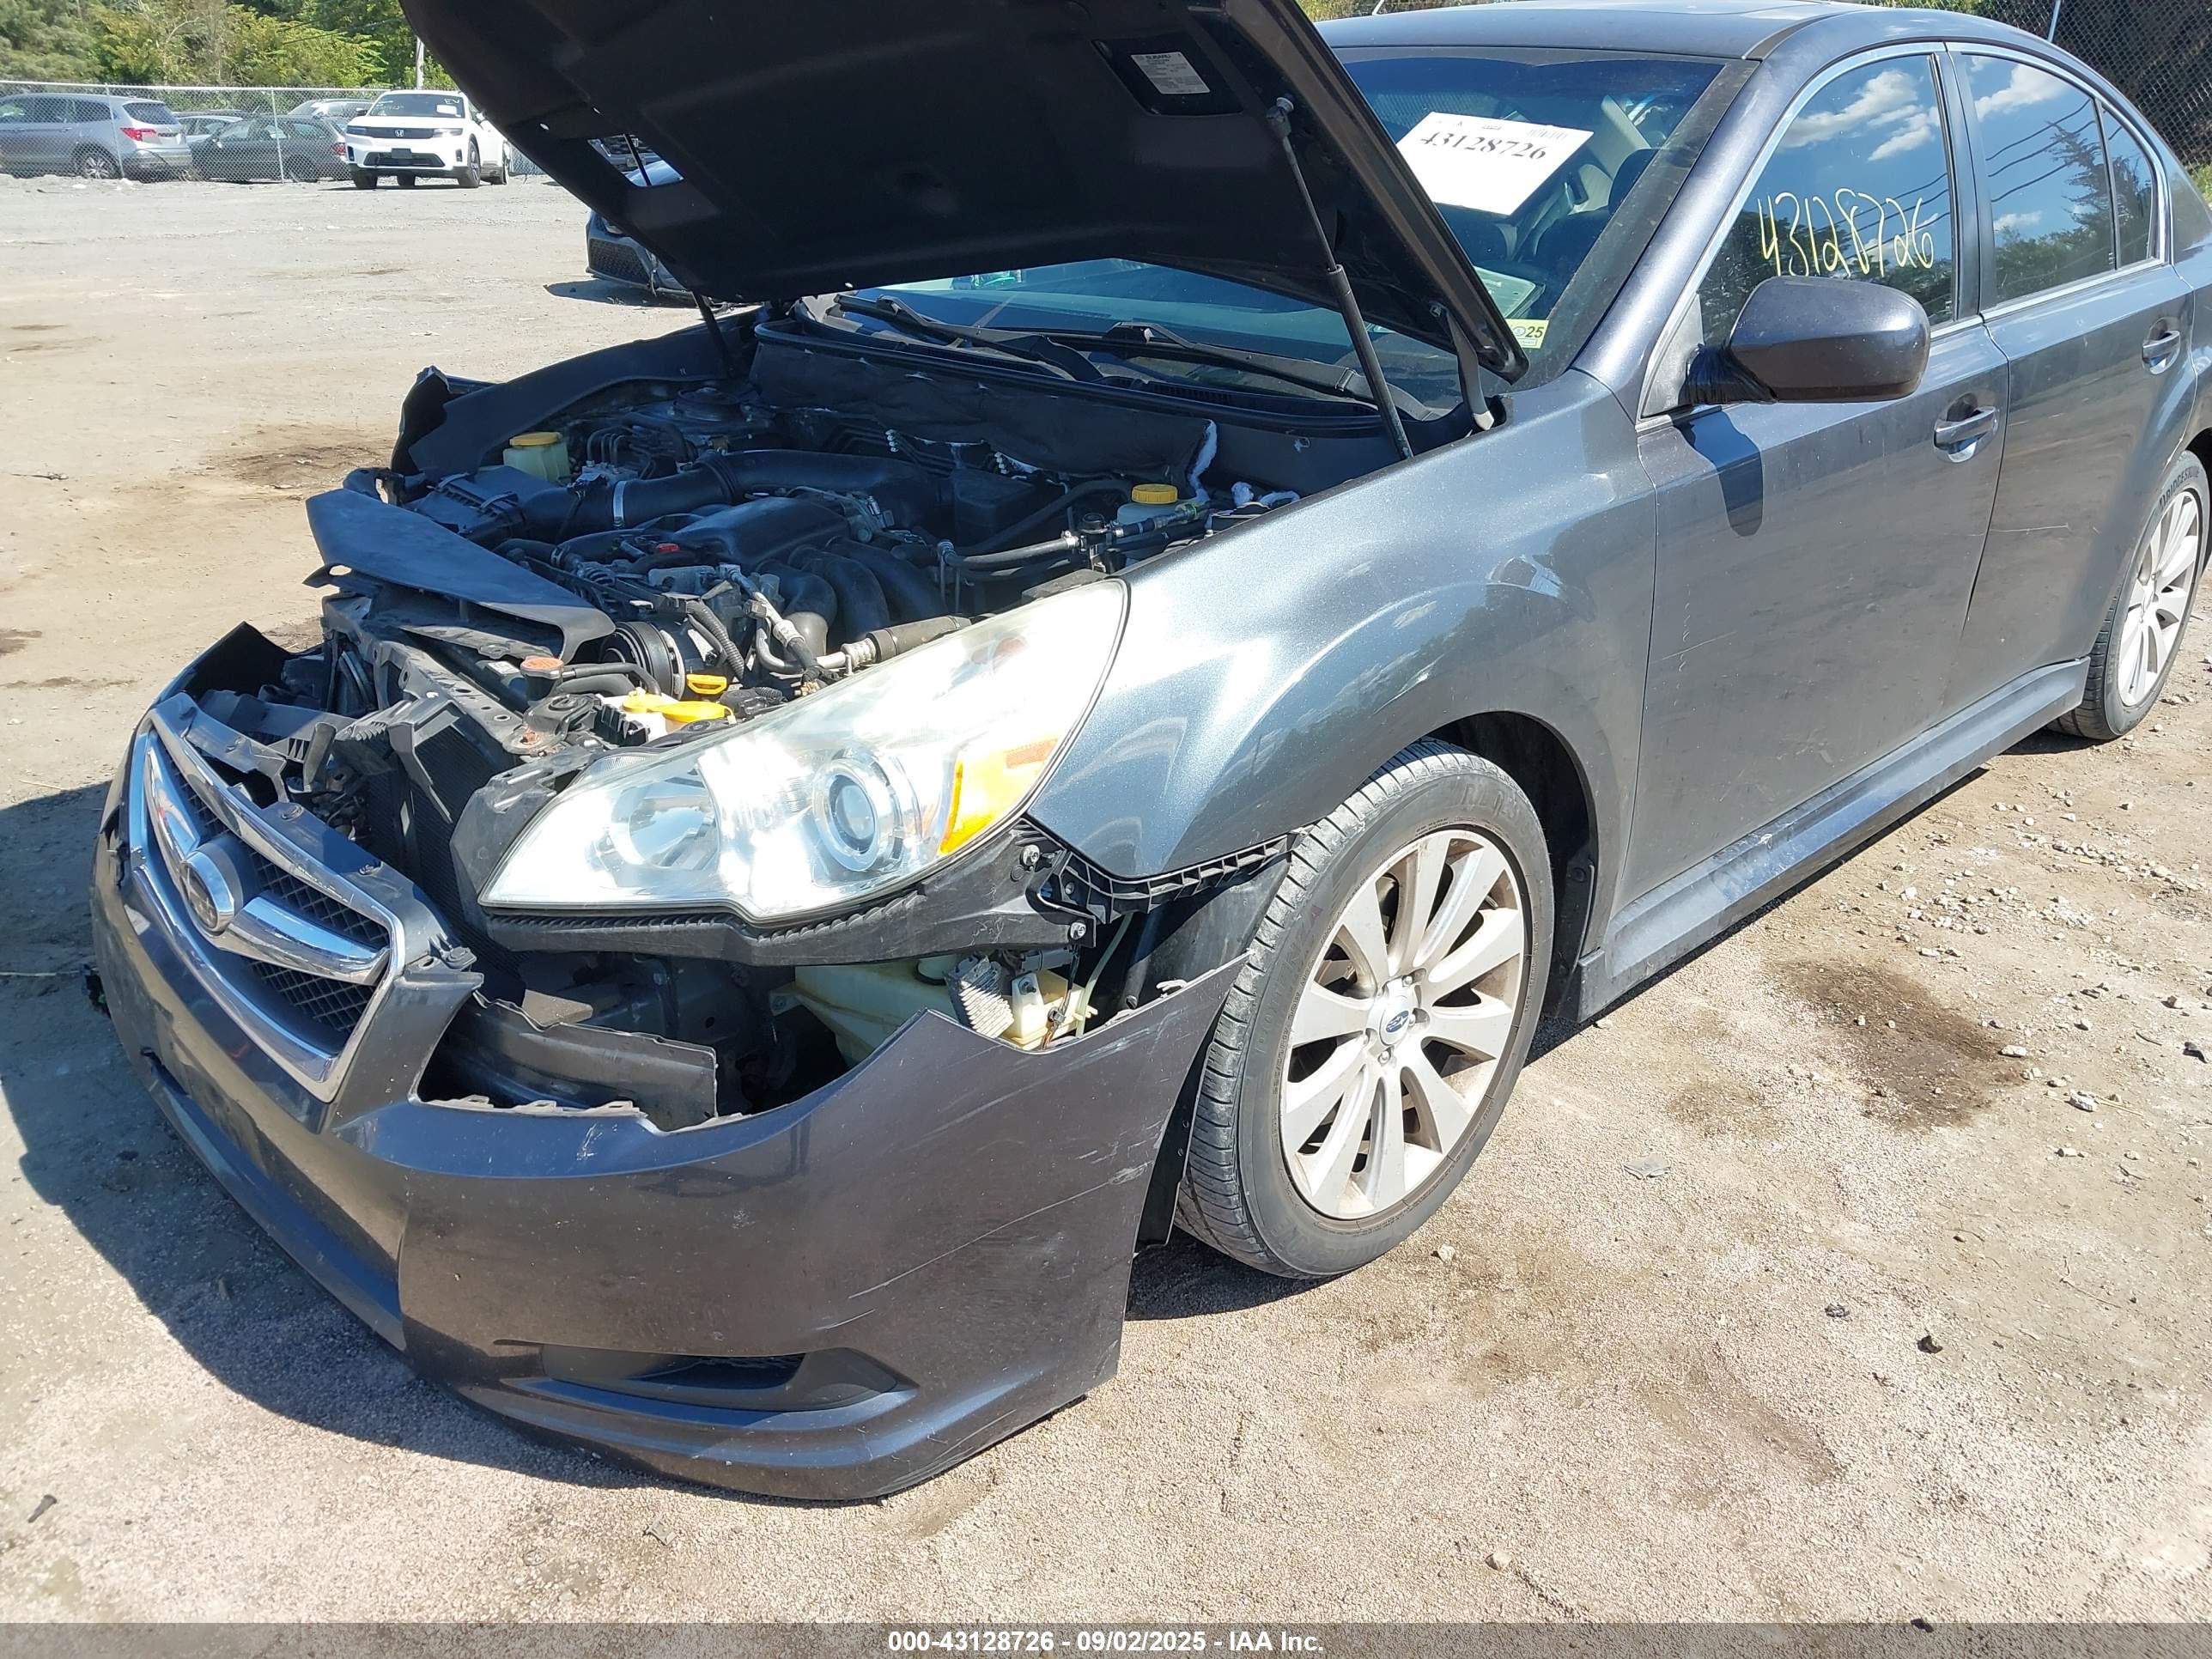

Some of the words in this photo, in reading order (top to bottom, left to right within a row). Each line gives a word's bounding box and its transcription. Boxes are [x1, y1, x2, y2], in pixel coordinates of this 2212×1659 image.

[1419, 131, 1547, 160] 43128726
[1757, 188, 1935, 277] 43128726
[1525, 325, 1545, 338] 25
